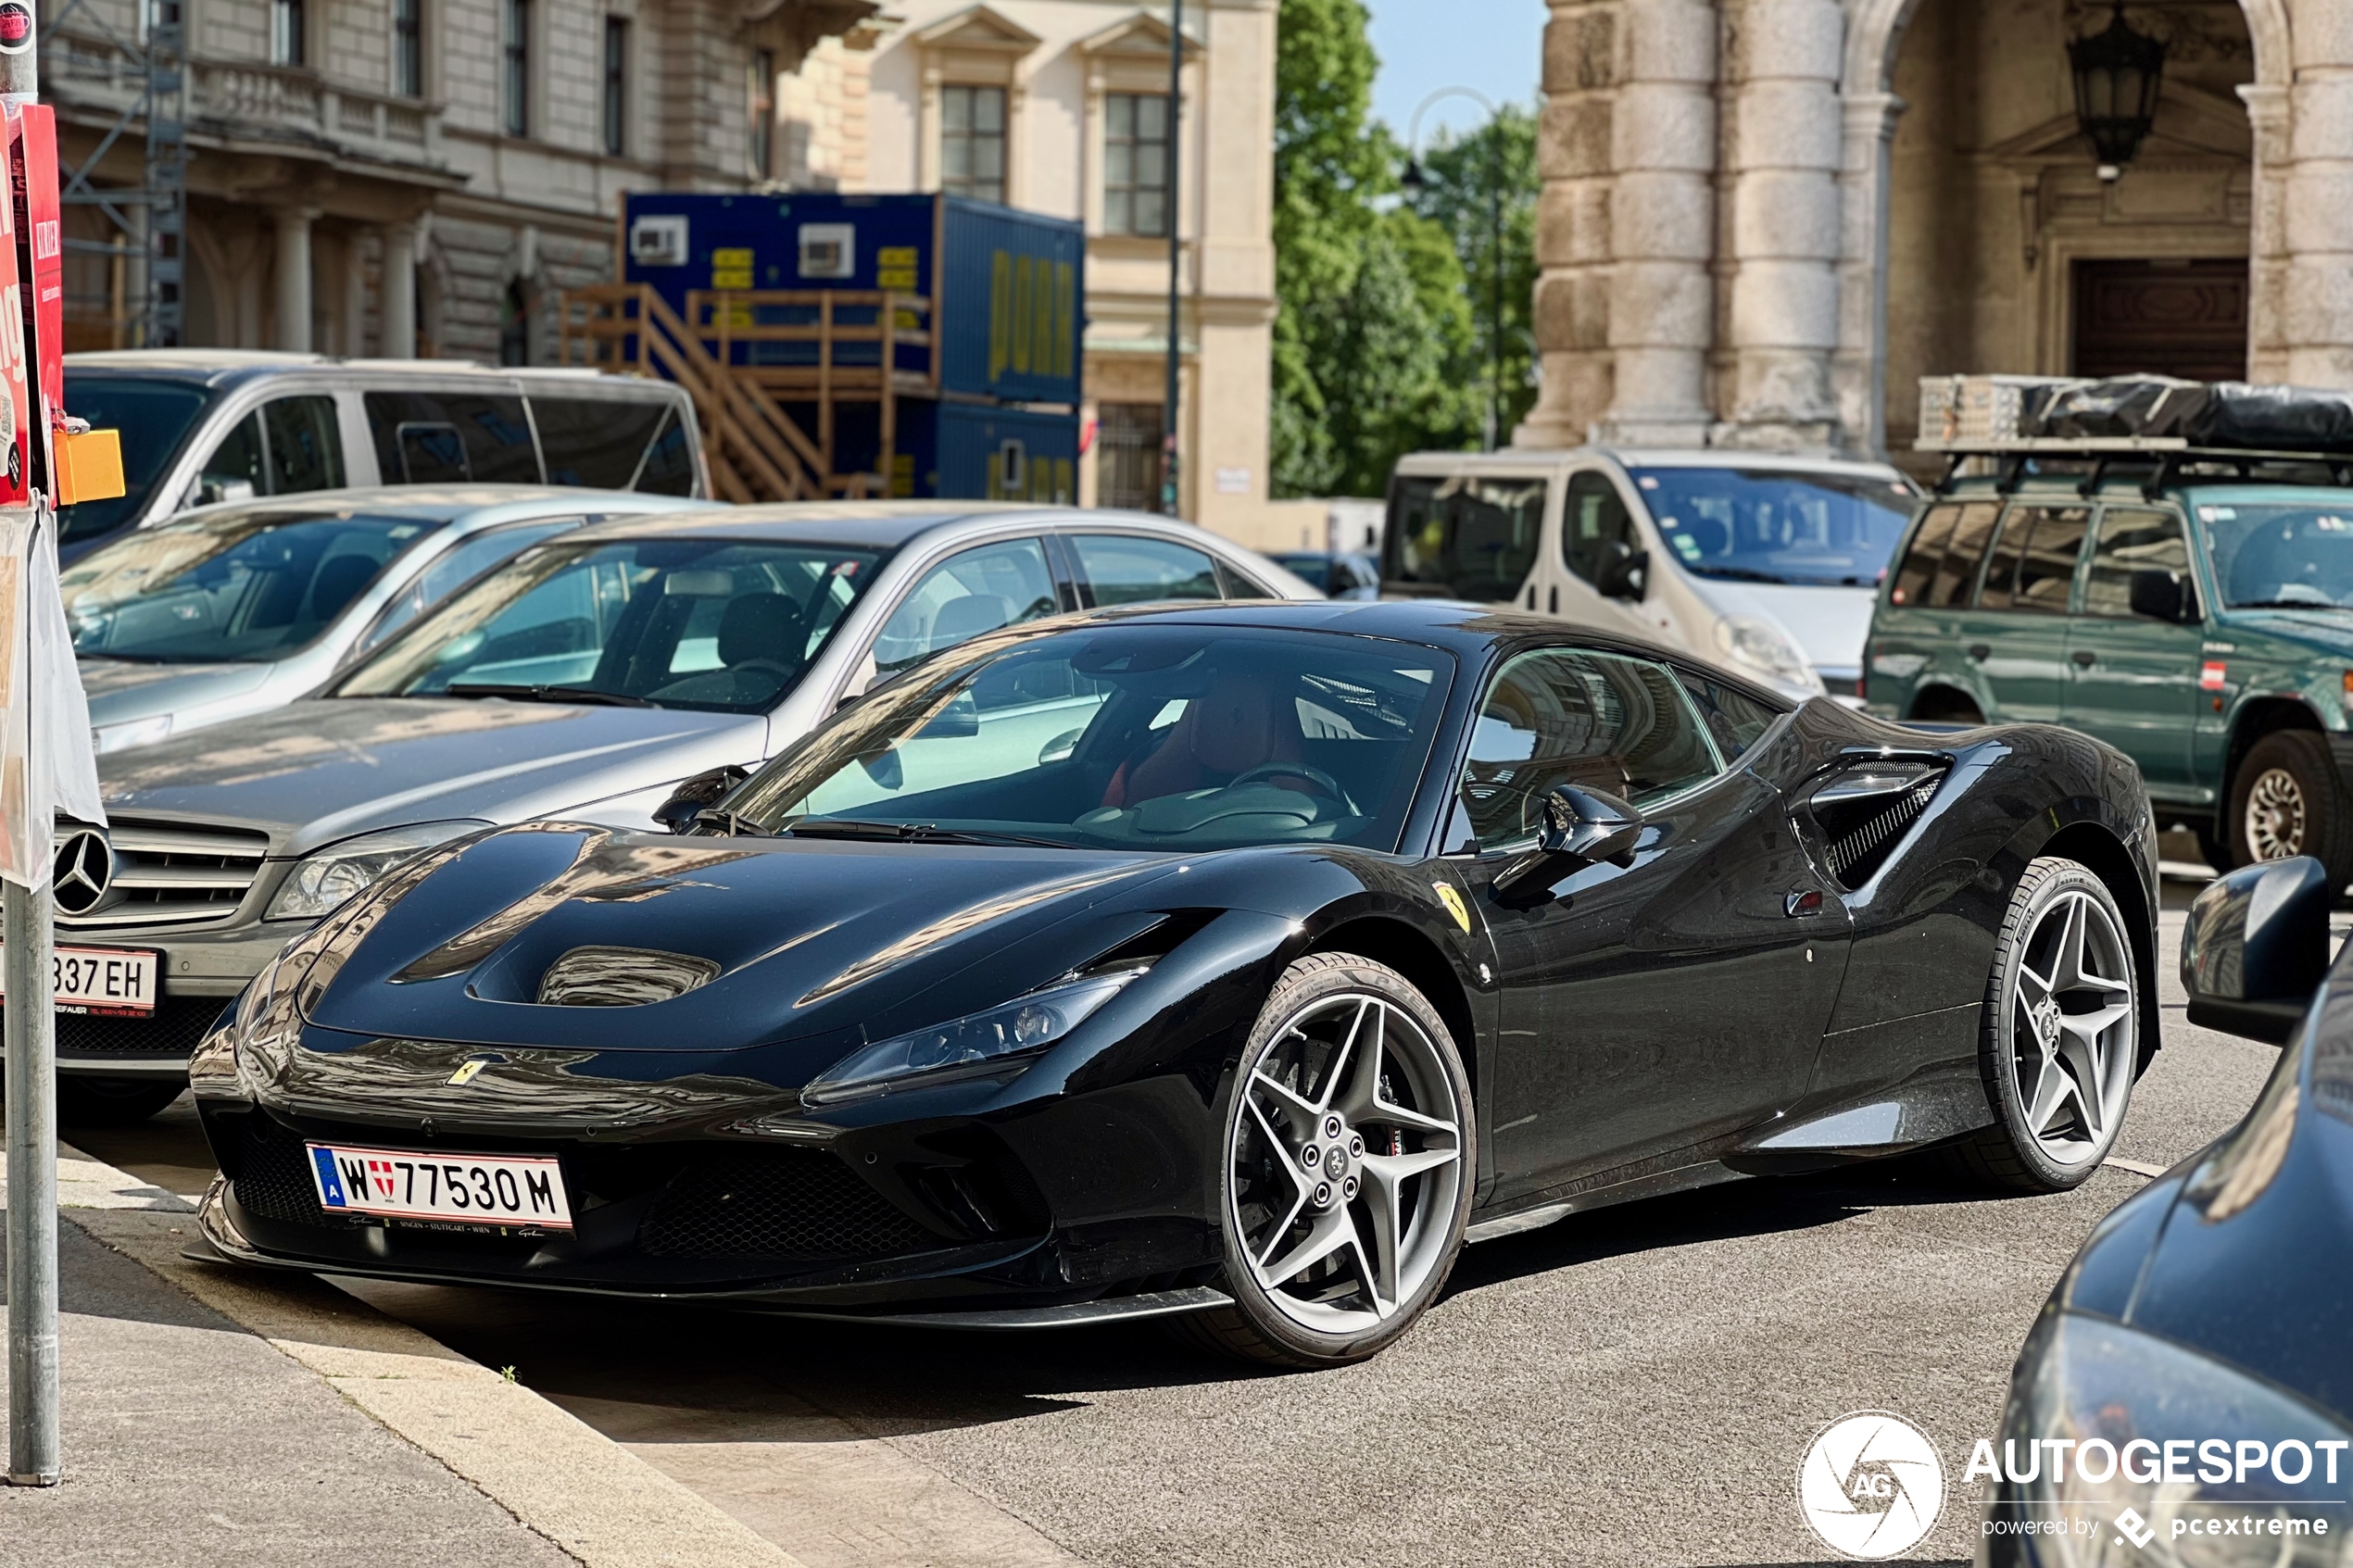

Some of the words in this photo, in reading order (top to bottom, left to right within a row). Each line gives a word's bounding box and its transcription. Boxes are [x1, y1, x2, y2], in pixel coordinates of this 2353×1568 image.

[106, 960, 142, 997] EH
[1390, 982, 1448, 1041] ZERO
[329, 1185, 339, 1198] A
[339, 1157, 370, 1201] W
[394, 1161, 521, 1211] 77530
[524, 1169, 556, 1214] M
[399, 1220, 423, 1229] SINGEN
[431, 1223, 465, 1232] STUTTGART
